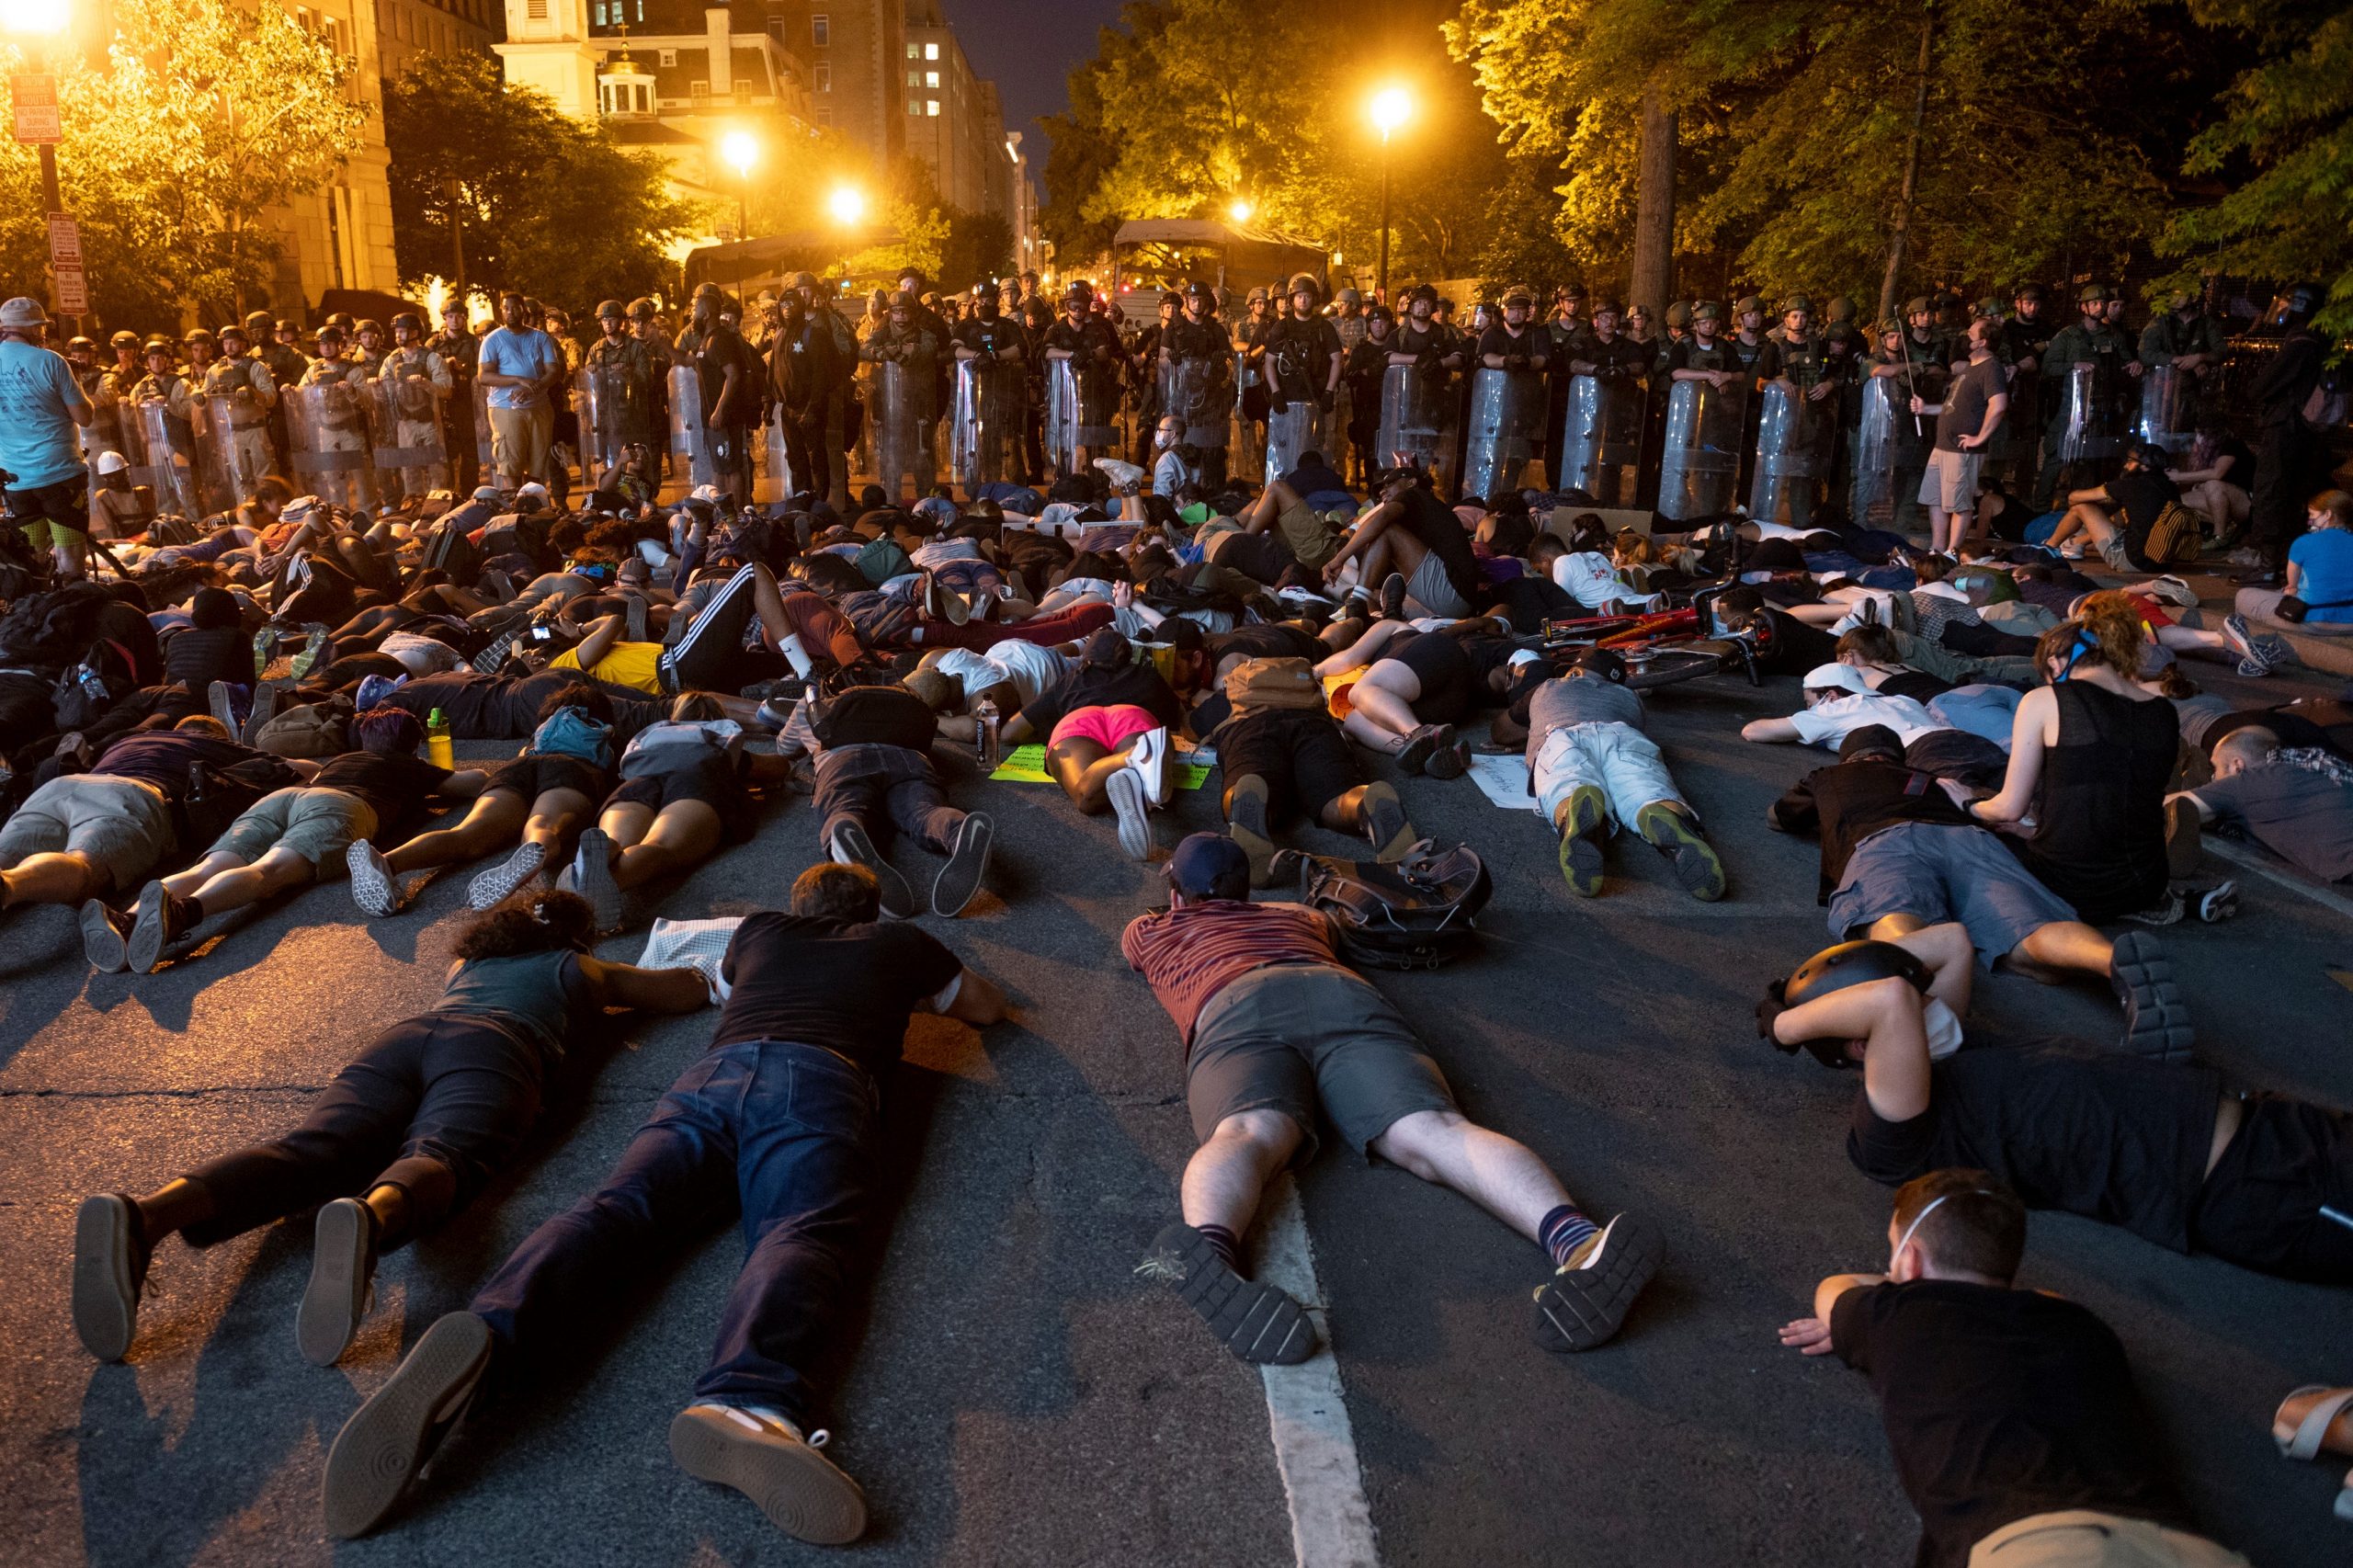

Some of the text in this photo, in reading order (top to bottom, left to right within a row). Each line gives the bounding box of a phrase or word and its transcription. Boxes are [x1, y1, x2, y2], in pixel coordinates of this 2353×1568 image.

[21, 95, 50, 105] ROUTE
[17, 107, 56, 117] NO PARKING
[27, 117, 50, 126] DURING
[20, 127, 57, 136] EMERGENCY
